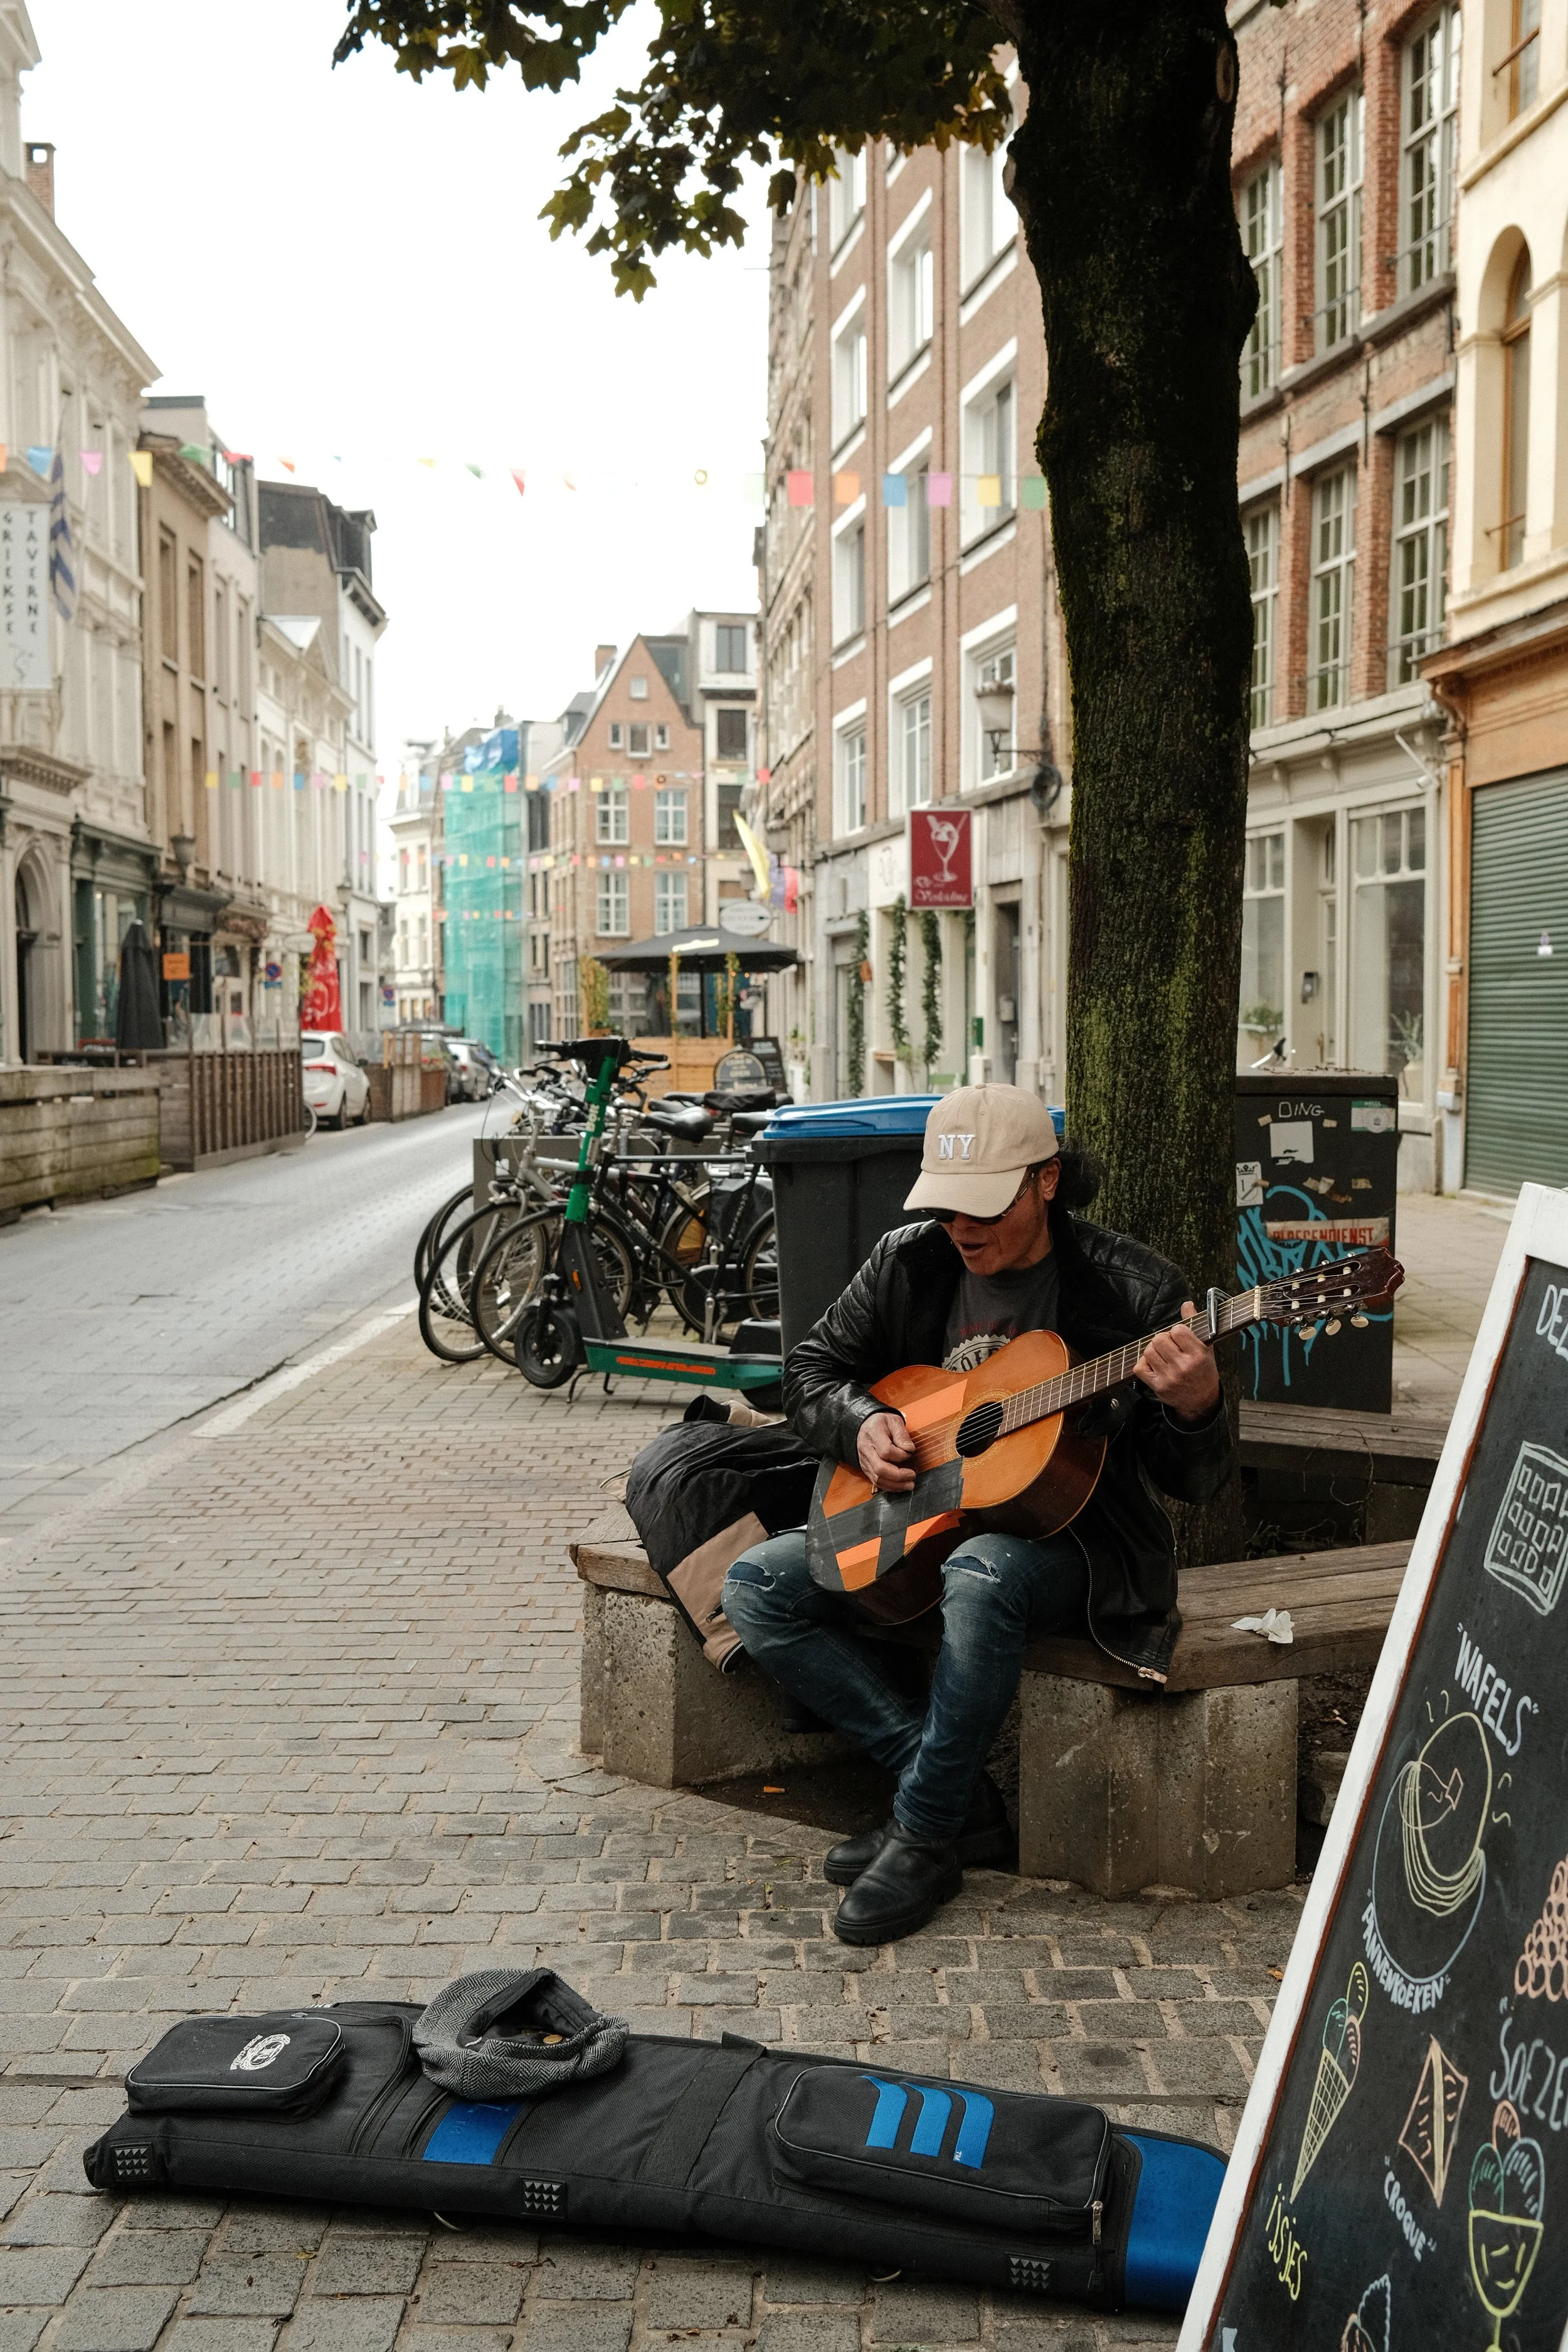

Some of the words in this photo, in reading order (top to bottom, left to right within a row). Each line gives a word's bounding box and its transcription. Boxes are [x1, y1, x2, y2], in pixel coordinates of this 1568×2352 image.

[3, 511, 13, 634] GRIEKSE
[26, 511, 38, 634] TAVERNE
[1279, 1101, 1325, 1118] DING
[938, 1134, 975, 1160] NY
